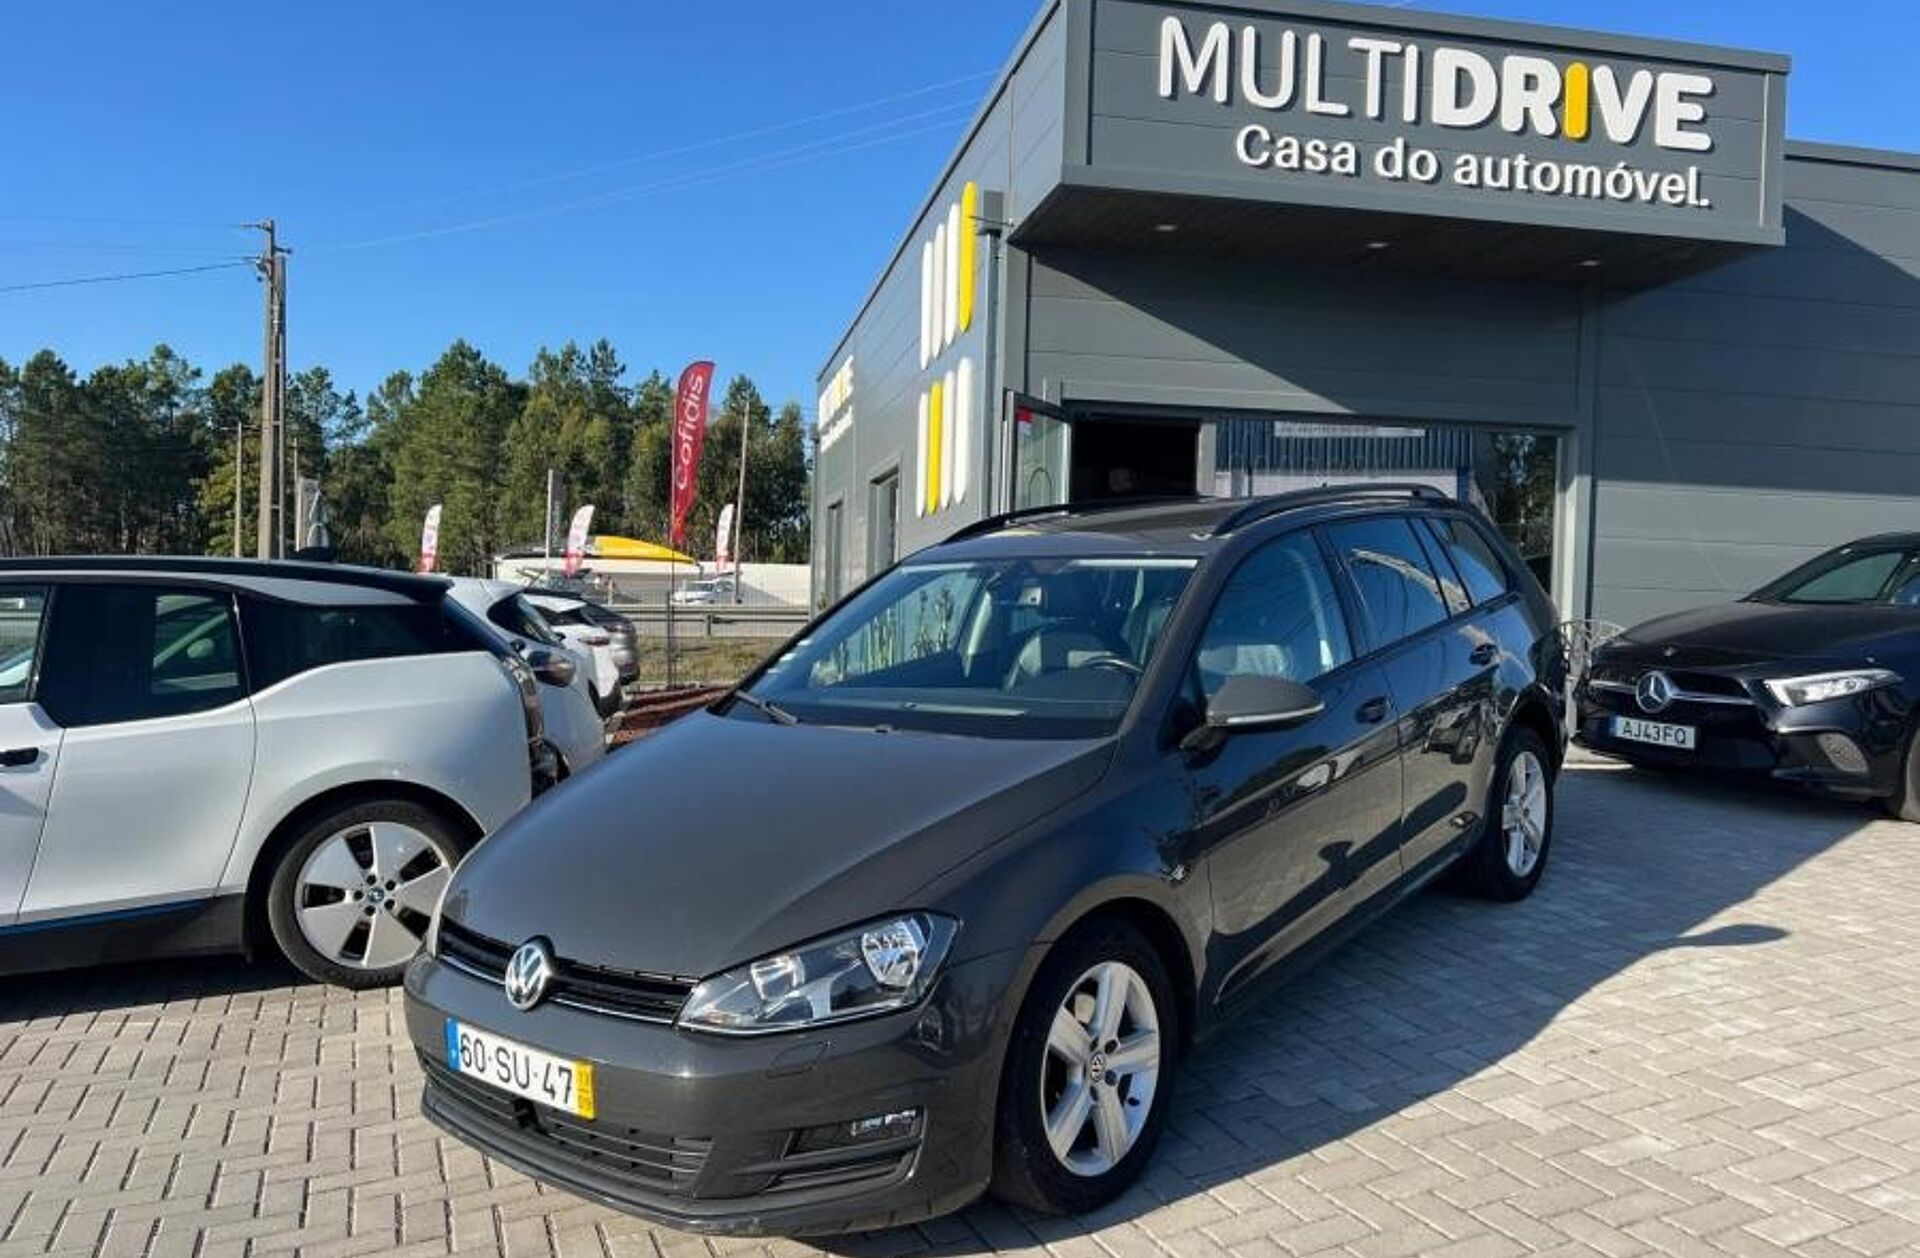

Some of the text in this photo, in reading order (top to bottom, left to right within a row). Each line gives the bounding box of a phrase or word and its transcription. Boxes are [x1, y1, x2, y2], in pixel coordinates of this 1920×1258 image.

[1159, 15, 1713, 151] MULTIDRIVE
[1236, 124, 1710, 206] Casa do automóvel.
[675, 373, 704, 490] cofidis
